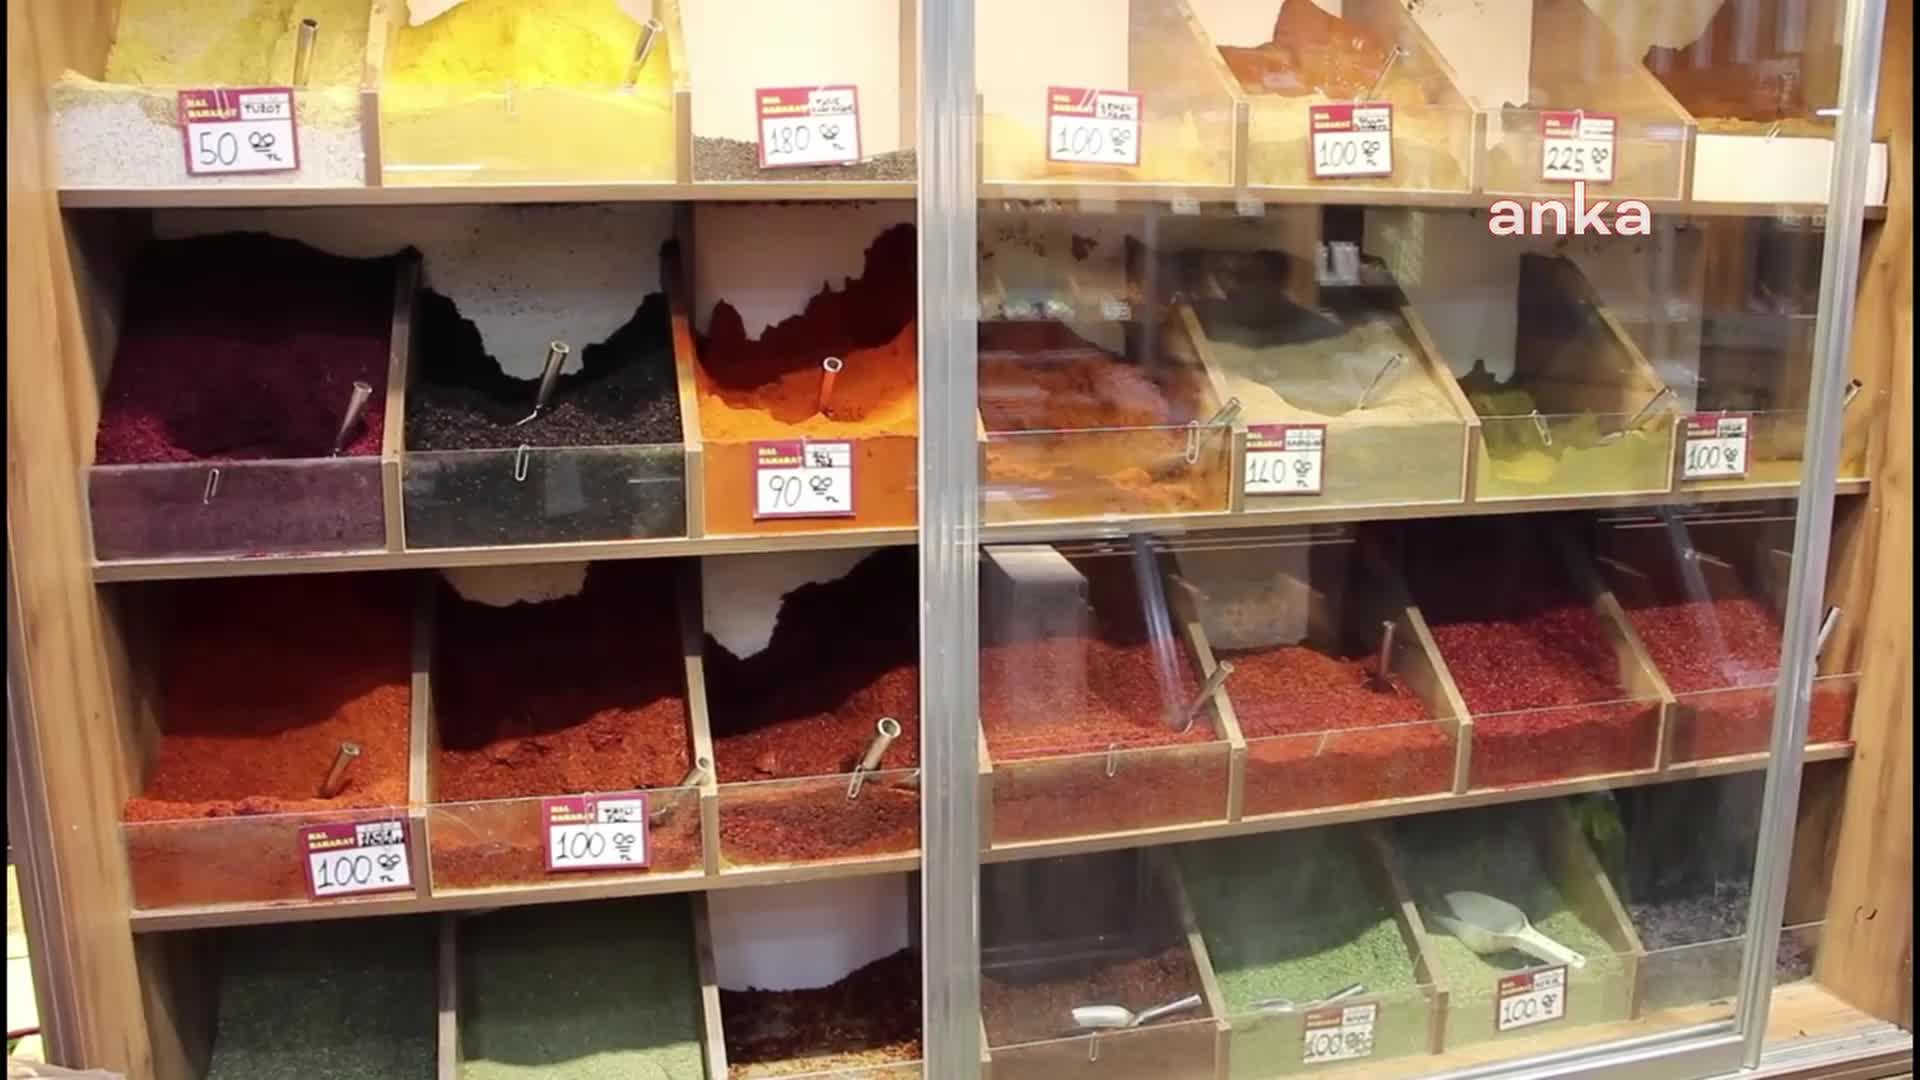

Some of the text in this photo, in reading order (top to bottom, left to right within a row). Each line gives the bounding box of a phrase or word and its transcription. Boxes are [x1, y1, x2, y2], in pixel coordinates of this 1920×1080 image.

[199, 131, 238, 165] 50
[768, 125, 810, 155] 180
[1056, 125, 1103, 155] 100
[1319, 139, 1357, 167] 100
[1546, 146, 1584, 173] 225
[1688, 446, 1720, 470] 100
[769, 475, 802, 508] 90
[556, 832, 606, 860] 100
[318, 855, 372, 889] 100
[1503, 998, 1537, 1024] 100
[1304, 1033, 1343, 1057] 100
